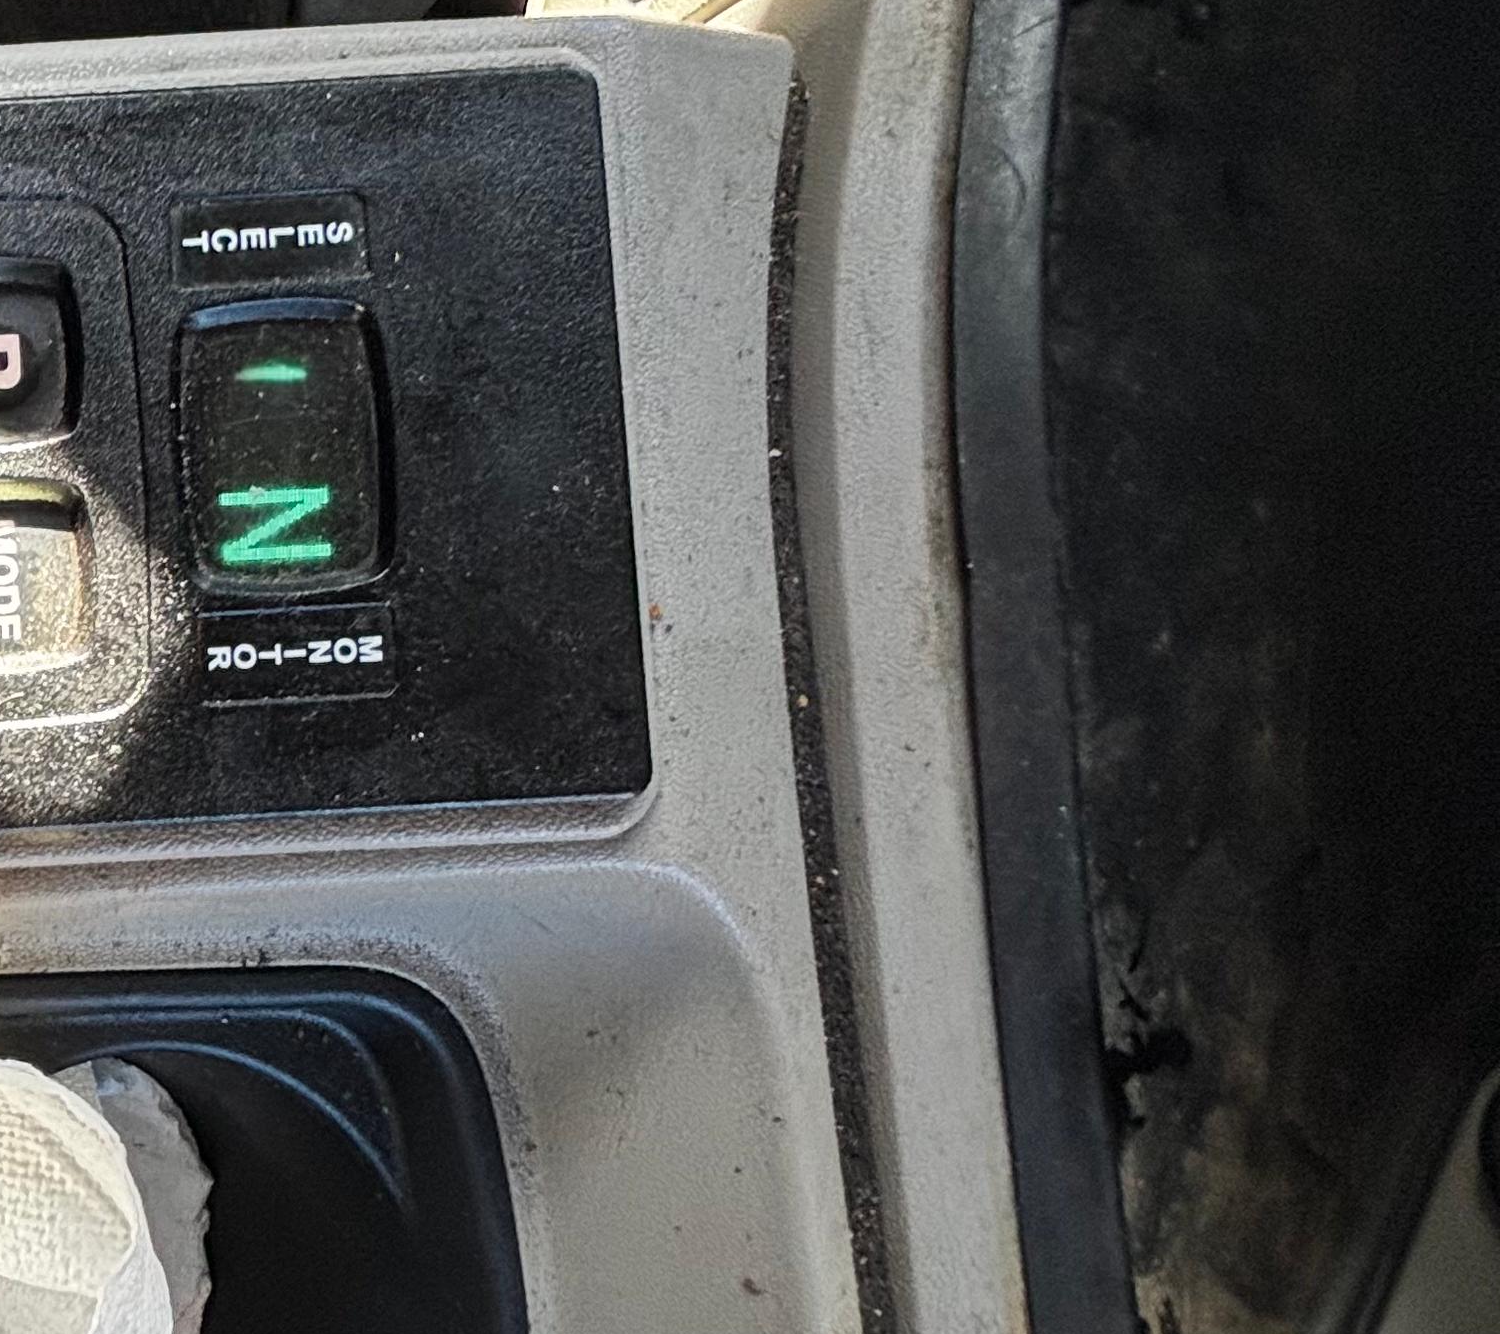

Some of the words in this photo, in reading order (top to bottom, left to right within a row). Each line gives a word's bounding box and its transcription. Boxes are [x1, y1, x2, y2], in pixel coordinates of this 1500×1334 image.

[181, 221, 354, 252] SELECT
[217, 484, 336, 565] N
[208, 634, 383, 671] MONITOR
